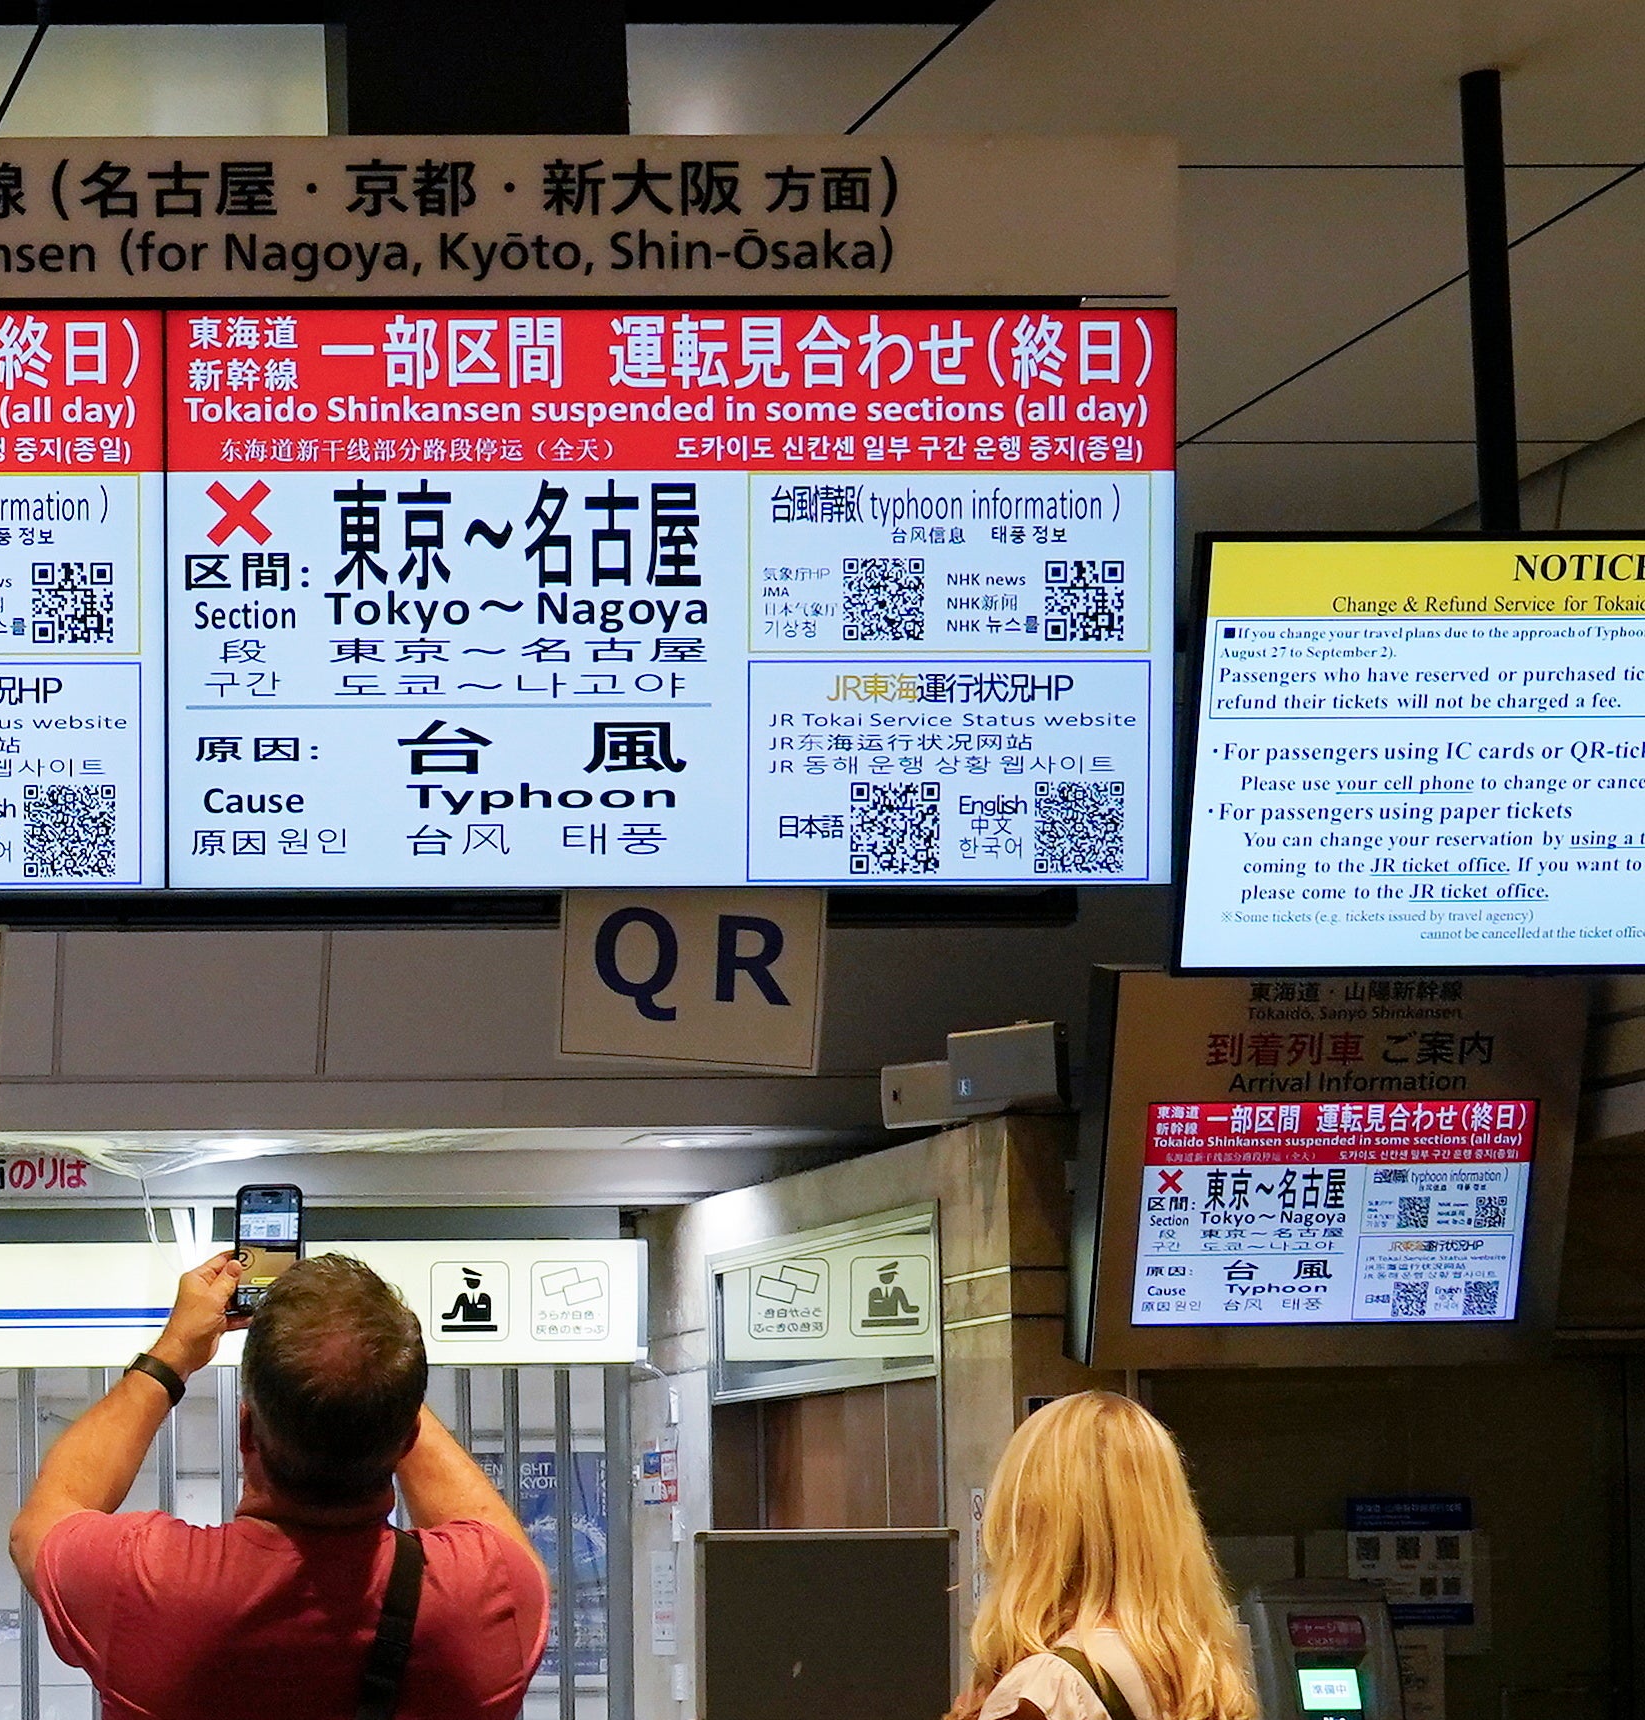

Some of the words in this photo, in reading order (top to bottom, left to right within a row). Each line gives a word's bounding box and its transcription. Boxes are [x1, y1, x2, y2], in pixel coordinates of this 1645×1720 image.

[119, 230, 209, 280] (for
[222, 230, 424, 280] Nagoya,
[436, 226, 597, 277] Kyōto,
[607, 223, 897, 275] Shin-Ōsaka)
[318, 317, 566, 393] 一部区間
[183, 395, 320, 425] Tokaido
[325, 395, 526, 425] Shinkansen
[529, 395, 716, 427] suspended
[723, 395, 757, 424] in
[762, 398, 860, 425] some
[863, 393, 1008, 425] sections
[1012, 393, 1069, 429] (all
[1072, 393, 1152, 430] day)
[673, 437, 776, 463] 도카이도
[783, 436, 858, 462] 신칸센
[861, 435, 913, 462] 일부
[918, 435, 967, 462] 구간
[972, 434, 1022, 462] 운행
[1028, 432, 1146, 464] 중지(종일)
[867, 488, 961, 525] typhoon
[966, 488, 1105, 522] information
[988, 522, 1028, 546] 태풍
[1031, 522, 1070, 546] 정보
[1332, 594, 1399, 614] Change
[1403, 595, 1418, 614] &
[1423, 595, 1489, 614] Refund
[1493, 595, 1557, 614] Service
[1563, 595, 1589, 613] for
[1216, 693, 1278, 712] refund
[1283, 693, 1327, 712] their
[1332, 693, 1390, 712] tickets
[1396, 693, 1429, 710] will
[1435, 693, 1464, 710] not
[1469, 693, 1493, 710] be
[1496, 693, 1570, 713] charged
[1574, 695, 1586, 710] a
[1591, 693, 1623, 710] fee.
[31, 715, 129, 732] website
[1240, 882, 1298, 905] please
[1301, 885, 1348, 902] come
[1353, 884, 1371, 901] to
[1376, 882, 1404, 901] the
[1408, 882, 1436, 900] JR
[1440, 882, 1490, 900] ticket
[1496, 882, 1550, 900] office.
[1205, 1032, 1365, 1067] 到着列車
[1381, 1031, 1494, 1065] ご案内
[1228, 1073, 1310, 1093] Arrival
[1319, 1073, 1467, 1092] Information
